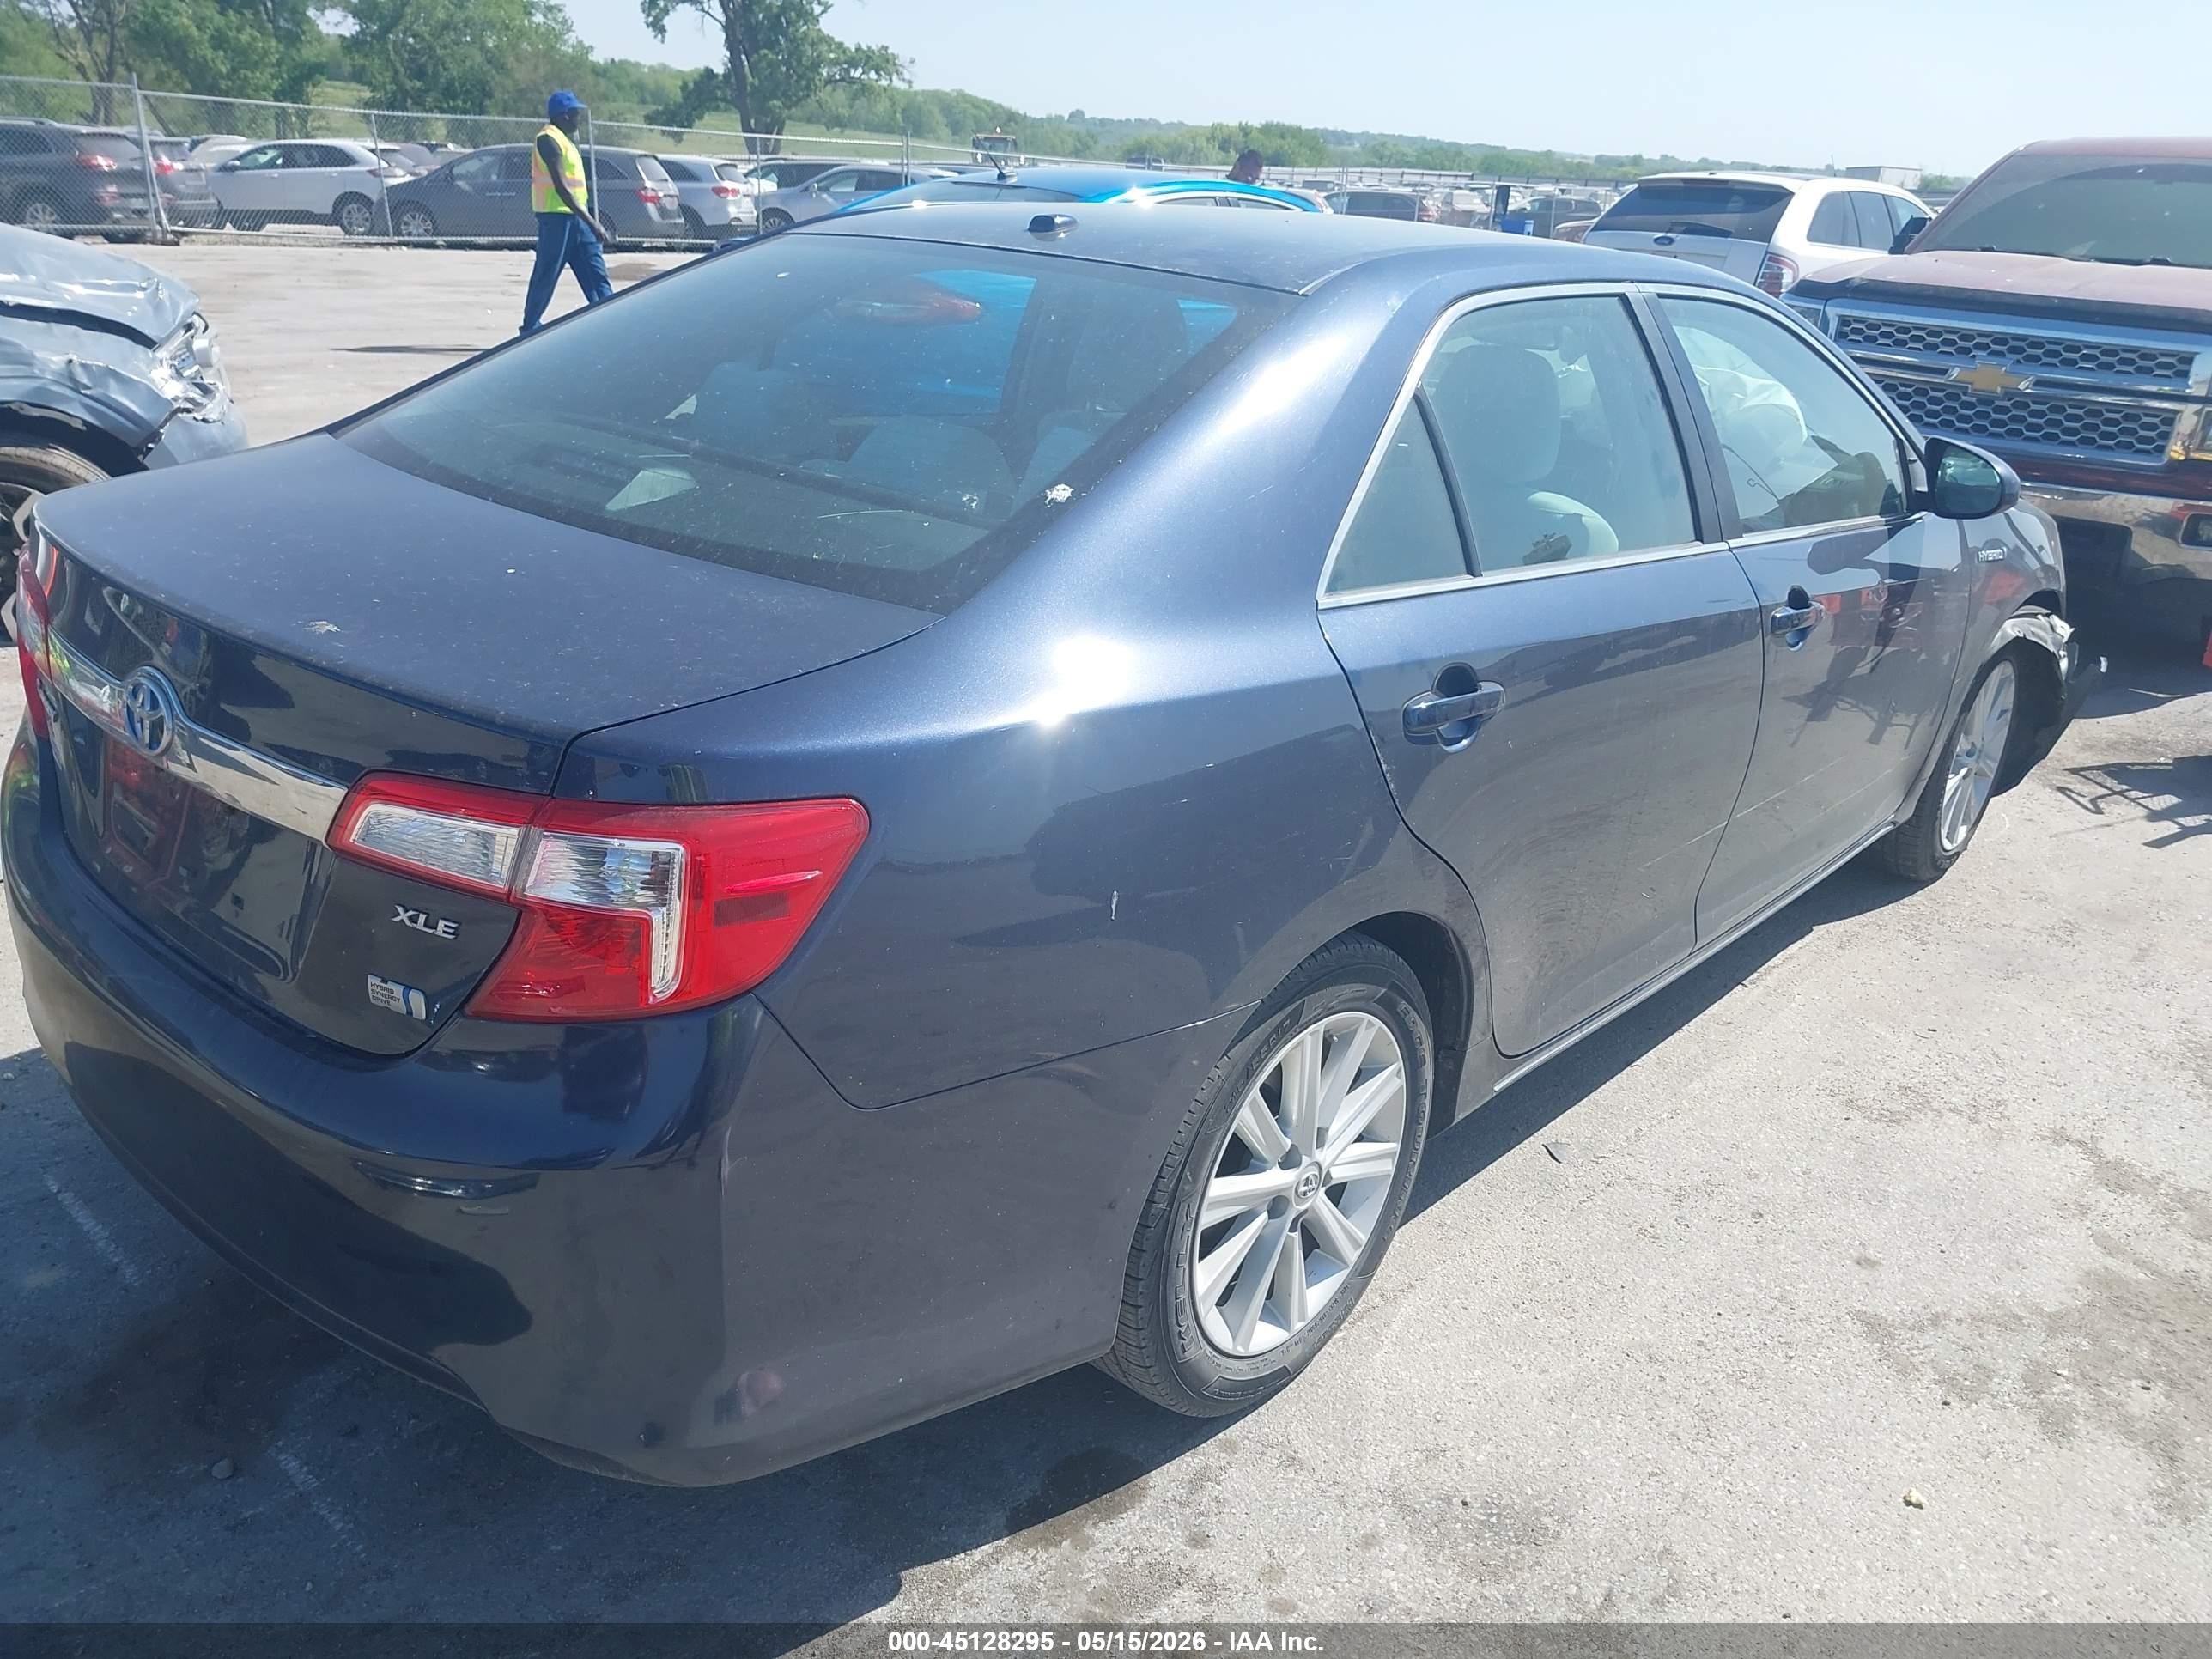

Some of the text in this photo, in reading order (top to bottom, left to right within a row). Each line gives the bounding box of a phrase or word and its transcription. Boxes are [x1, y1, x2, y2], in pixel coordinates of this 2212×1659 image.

[391, 903, 460, 939] XLE
[370, 981, 395, 994] HYBRID
[370, 988, 401, 1004] SYNERGY
[371, 994, 392, 1006] DRIVE
[1174, 1203, 1195, 1354] KELLY
